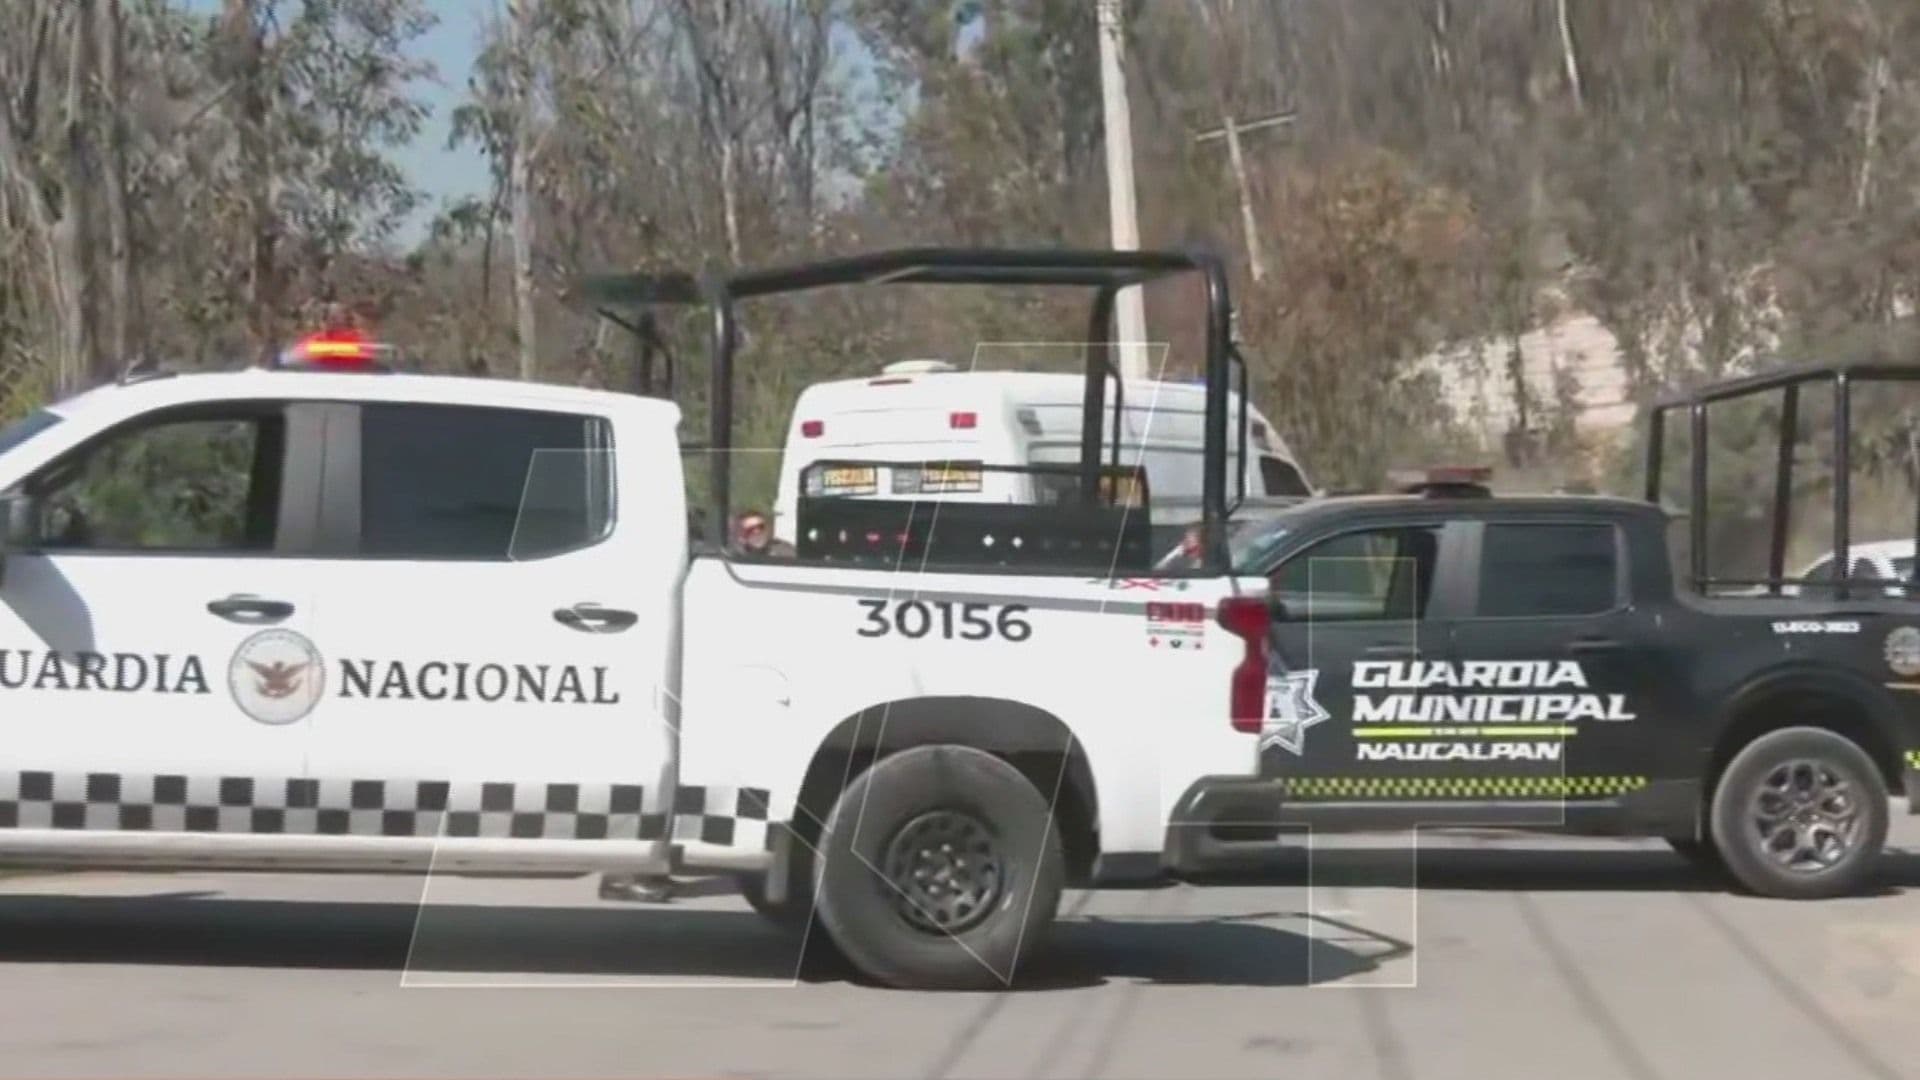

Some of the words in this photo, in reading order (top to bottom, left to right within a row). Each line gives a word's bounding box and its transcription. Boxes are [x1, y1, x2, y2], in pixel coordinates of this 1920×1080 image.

[857, 599, 1032, 642] 30156
[338, 658, 620, 704] NACIONAL
[1351, 661, 1588, 688] GUARDIA
[1351, 694, 1637, 722] MUNICIPAL
[1357, 742, 1561, 760] NAUCALPAN
